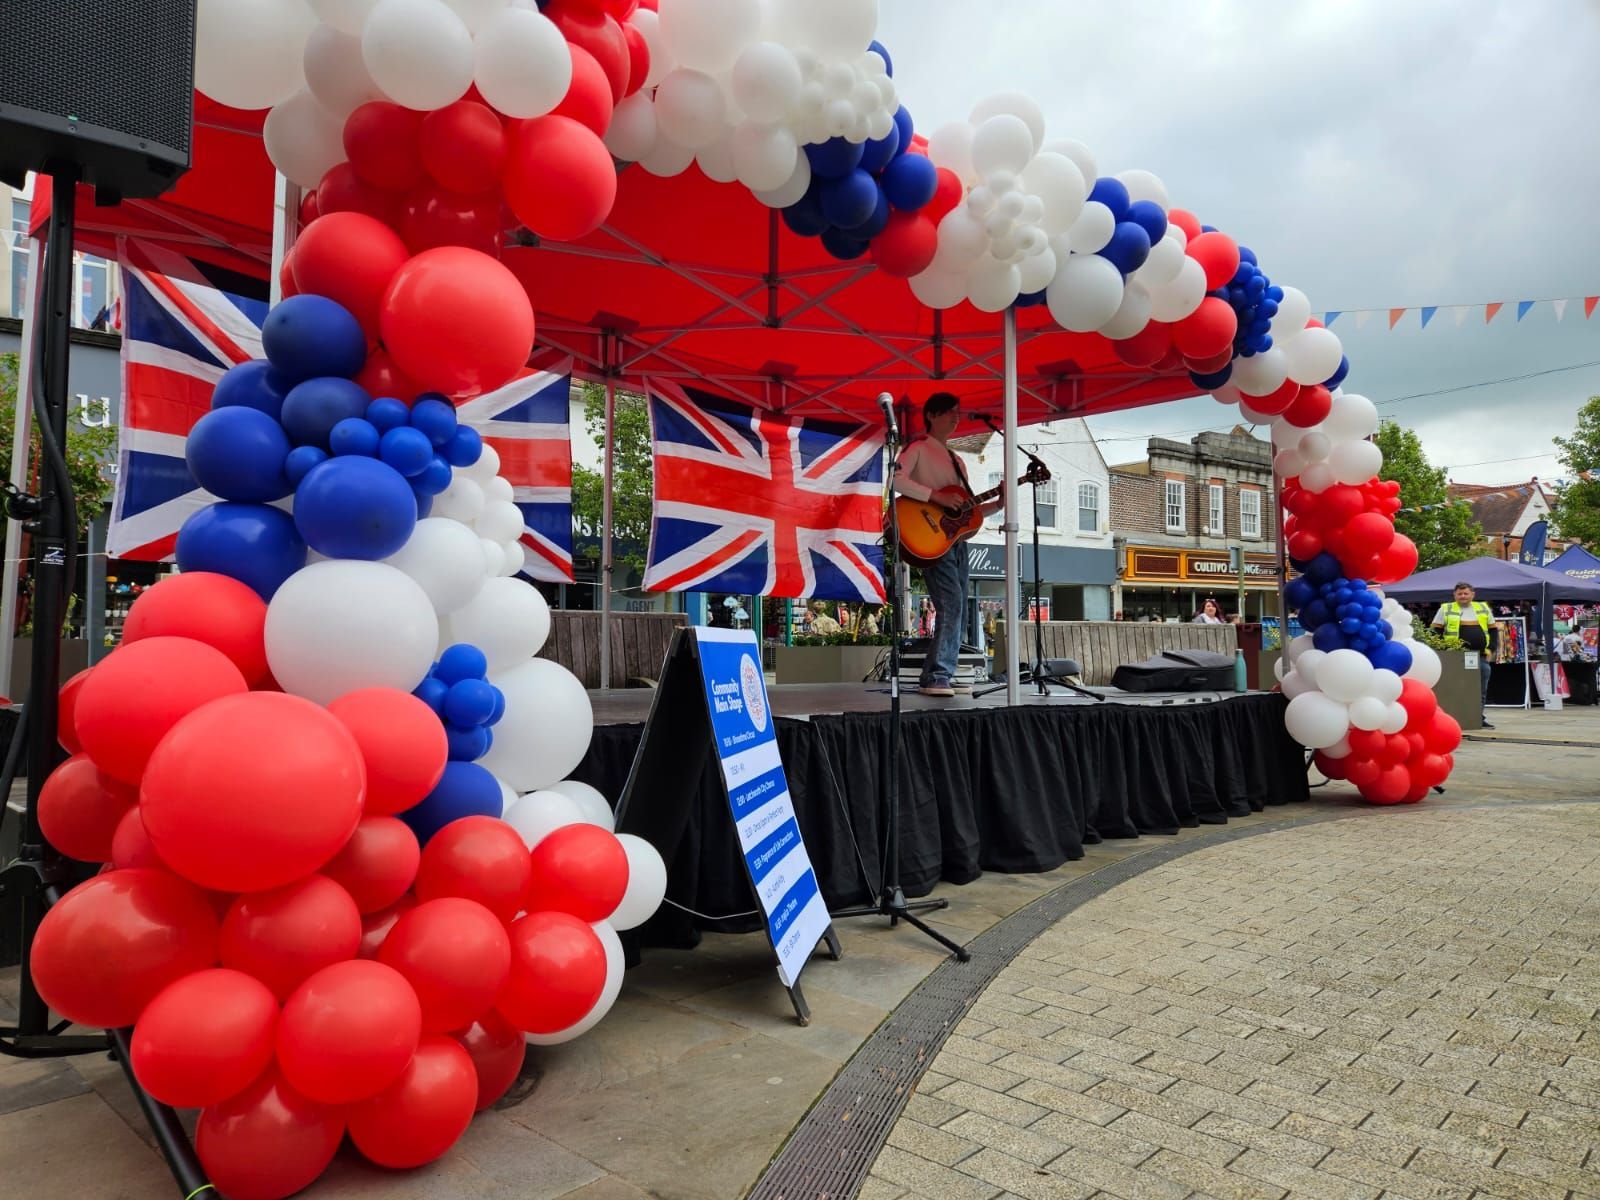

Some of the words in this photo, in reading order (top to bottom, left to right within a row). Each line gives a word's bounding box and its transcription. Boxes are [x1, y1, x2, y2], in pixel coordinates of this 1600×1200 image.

[1194, 561, 1227, 573] CULTIVO
[1229, 563, 1259, 575] LNGE
[625, 600, 656, 612] AGENT
[711, 677, 740, 697] Community
[714, 695, 729, 714] Main
[727, 694, 743, 714] Stage
